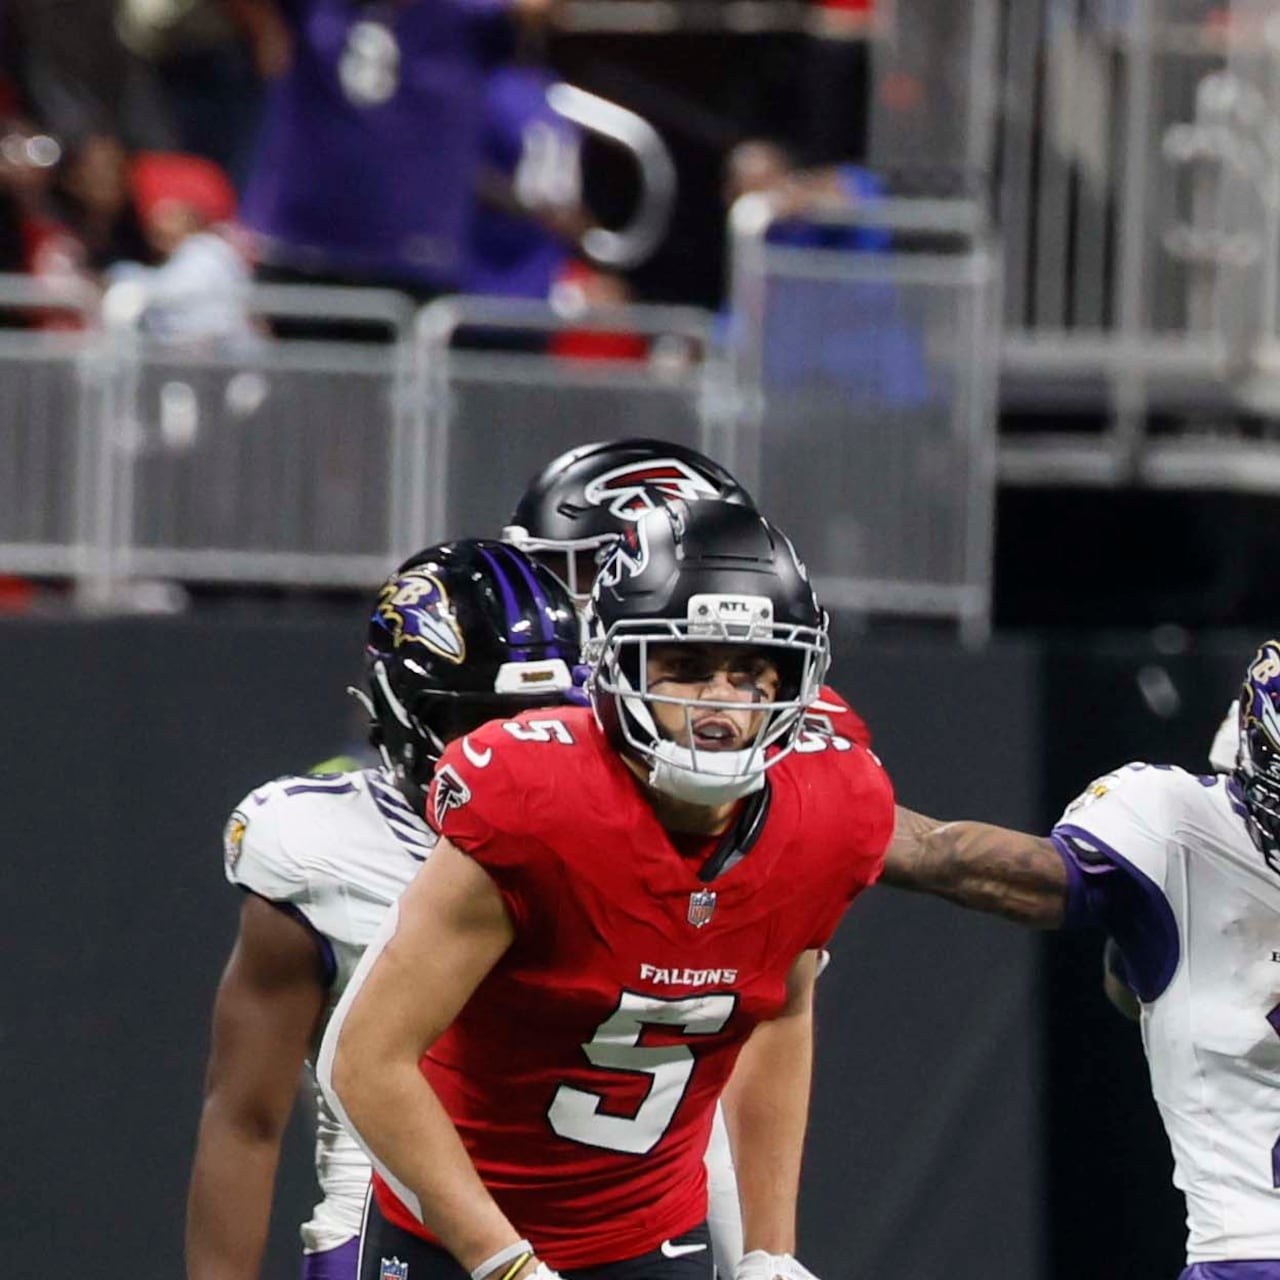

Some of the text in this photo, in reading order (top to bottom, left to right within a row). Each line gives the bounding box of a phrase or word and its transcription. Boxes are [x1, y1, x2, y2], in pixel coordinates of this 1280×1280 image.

[718, 601, 750, 613] ATL
[502, 718, 576, 746] 5
[639, 962, 739, 987] FALCONS
[547, 986, 741, 1156] 5
